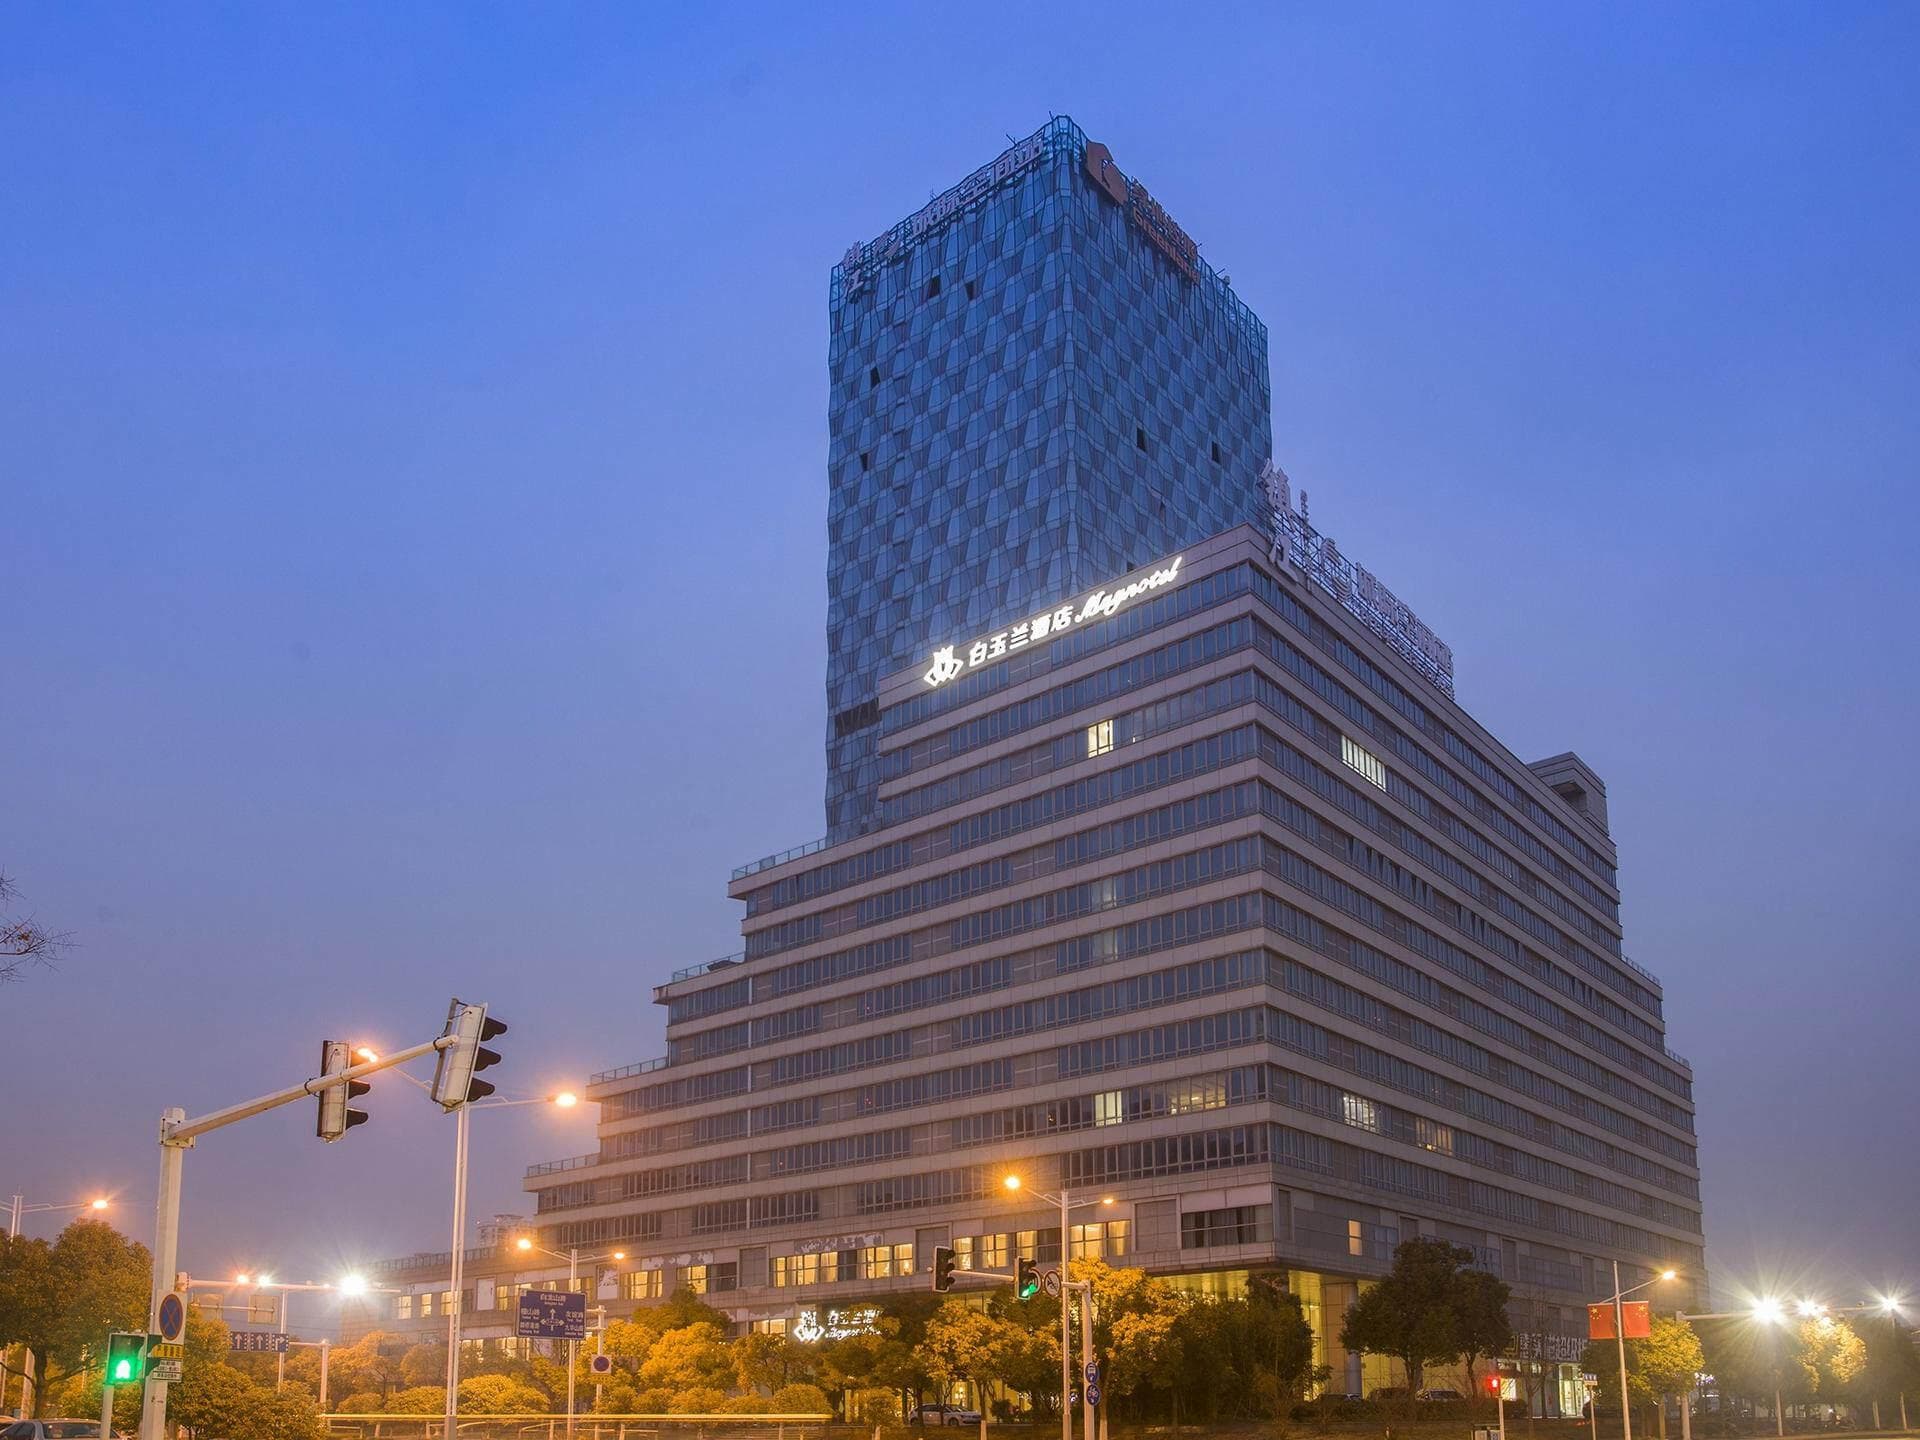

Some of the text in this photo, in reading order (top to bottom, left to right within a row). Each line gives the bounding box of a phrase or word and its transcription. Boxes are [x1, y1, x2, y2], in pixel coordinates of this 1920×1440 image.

[968, 605, 1074, 668] 白玉兰酒店
